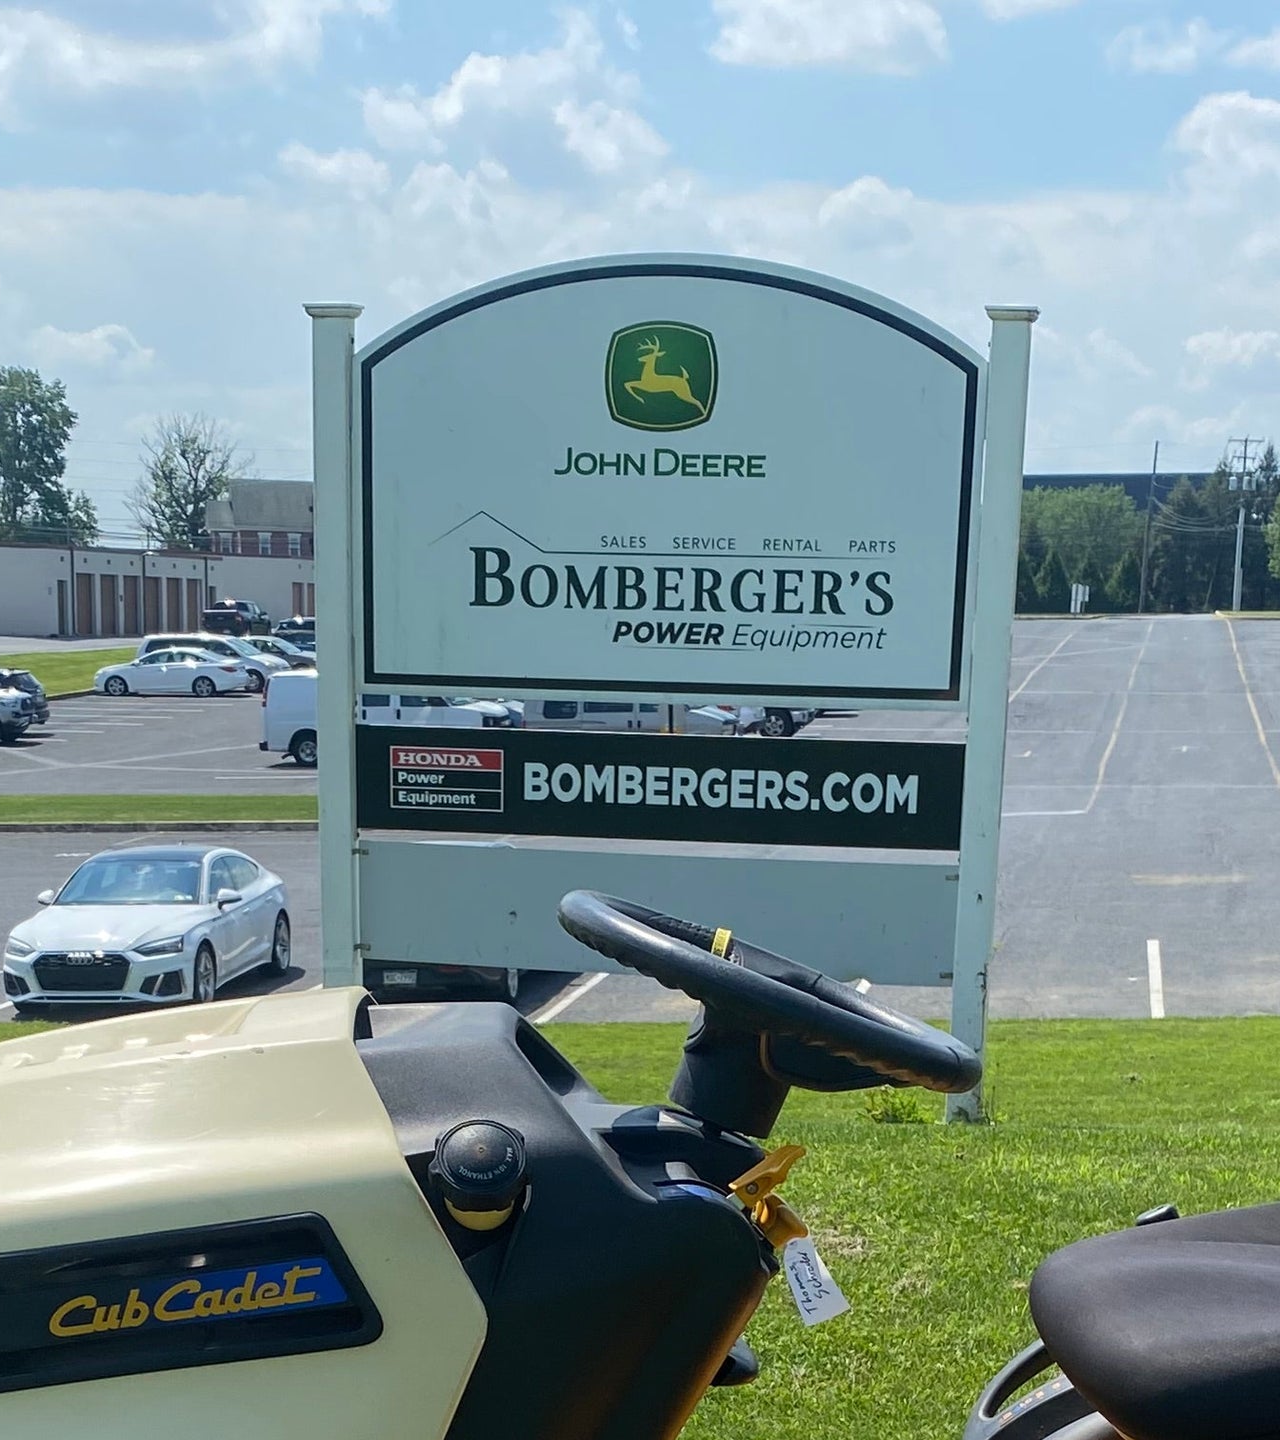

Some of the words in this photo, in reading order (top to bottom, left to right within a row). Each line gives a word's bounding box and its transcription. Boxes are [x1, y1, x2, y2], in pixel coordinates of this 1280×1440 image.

[553, 447, 646, 476] JOHN
[653, 448, 767, 478] DEERE
[600, 535, 647, 549] SALES
[672, 536, 737, 551] SERVICE
[762, 538, 822, 553] RENTAL
[848, 539, 896, 554] PARTS
[468, 546, 895, 616] BOMBERGER'S
[612, 621, 725, 646] POWER
[731, 623, 888, 652] Equipment
[397, 752, 483, 767] HONDA
[397, 771, 445, 785] Power
[523, 761, 919, 815] BOMBERGERS.COM
[397, 791, 477, 806] Equipment
[48, 1289, 150, 1338] Cub
[153, 1265, 322, 1321] Cadet
